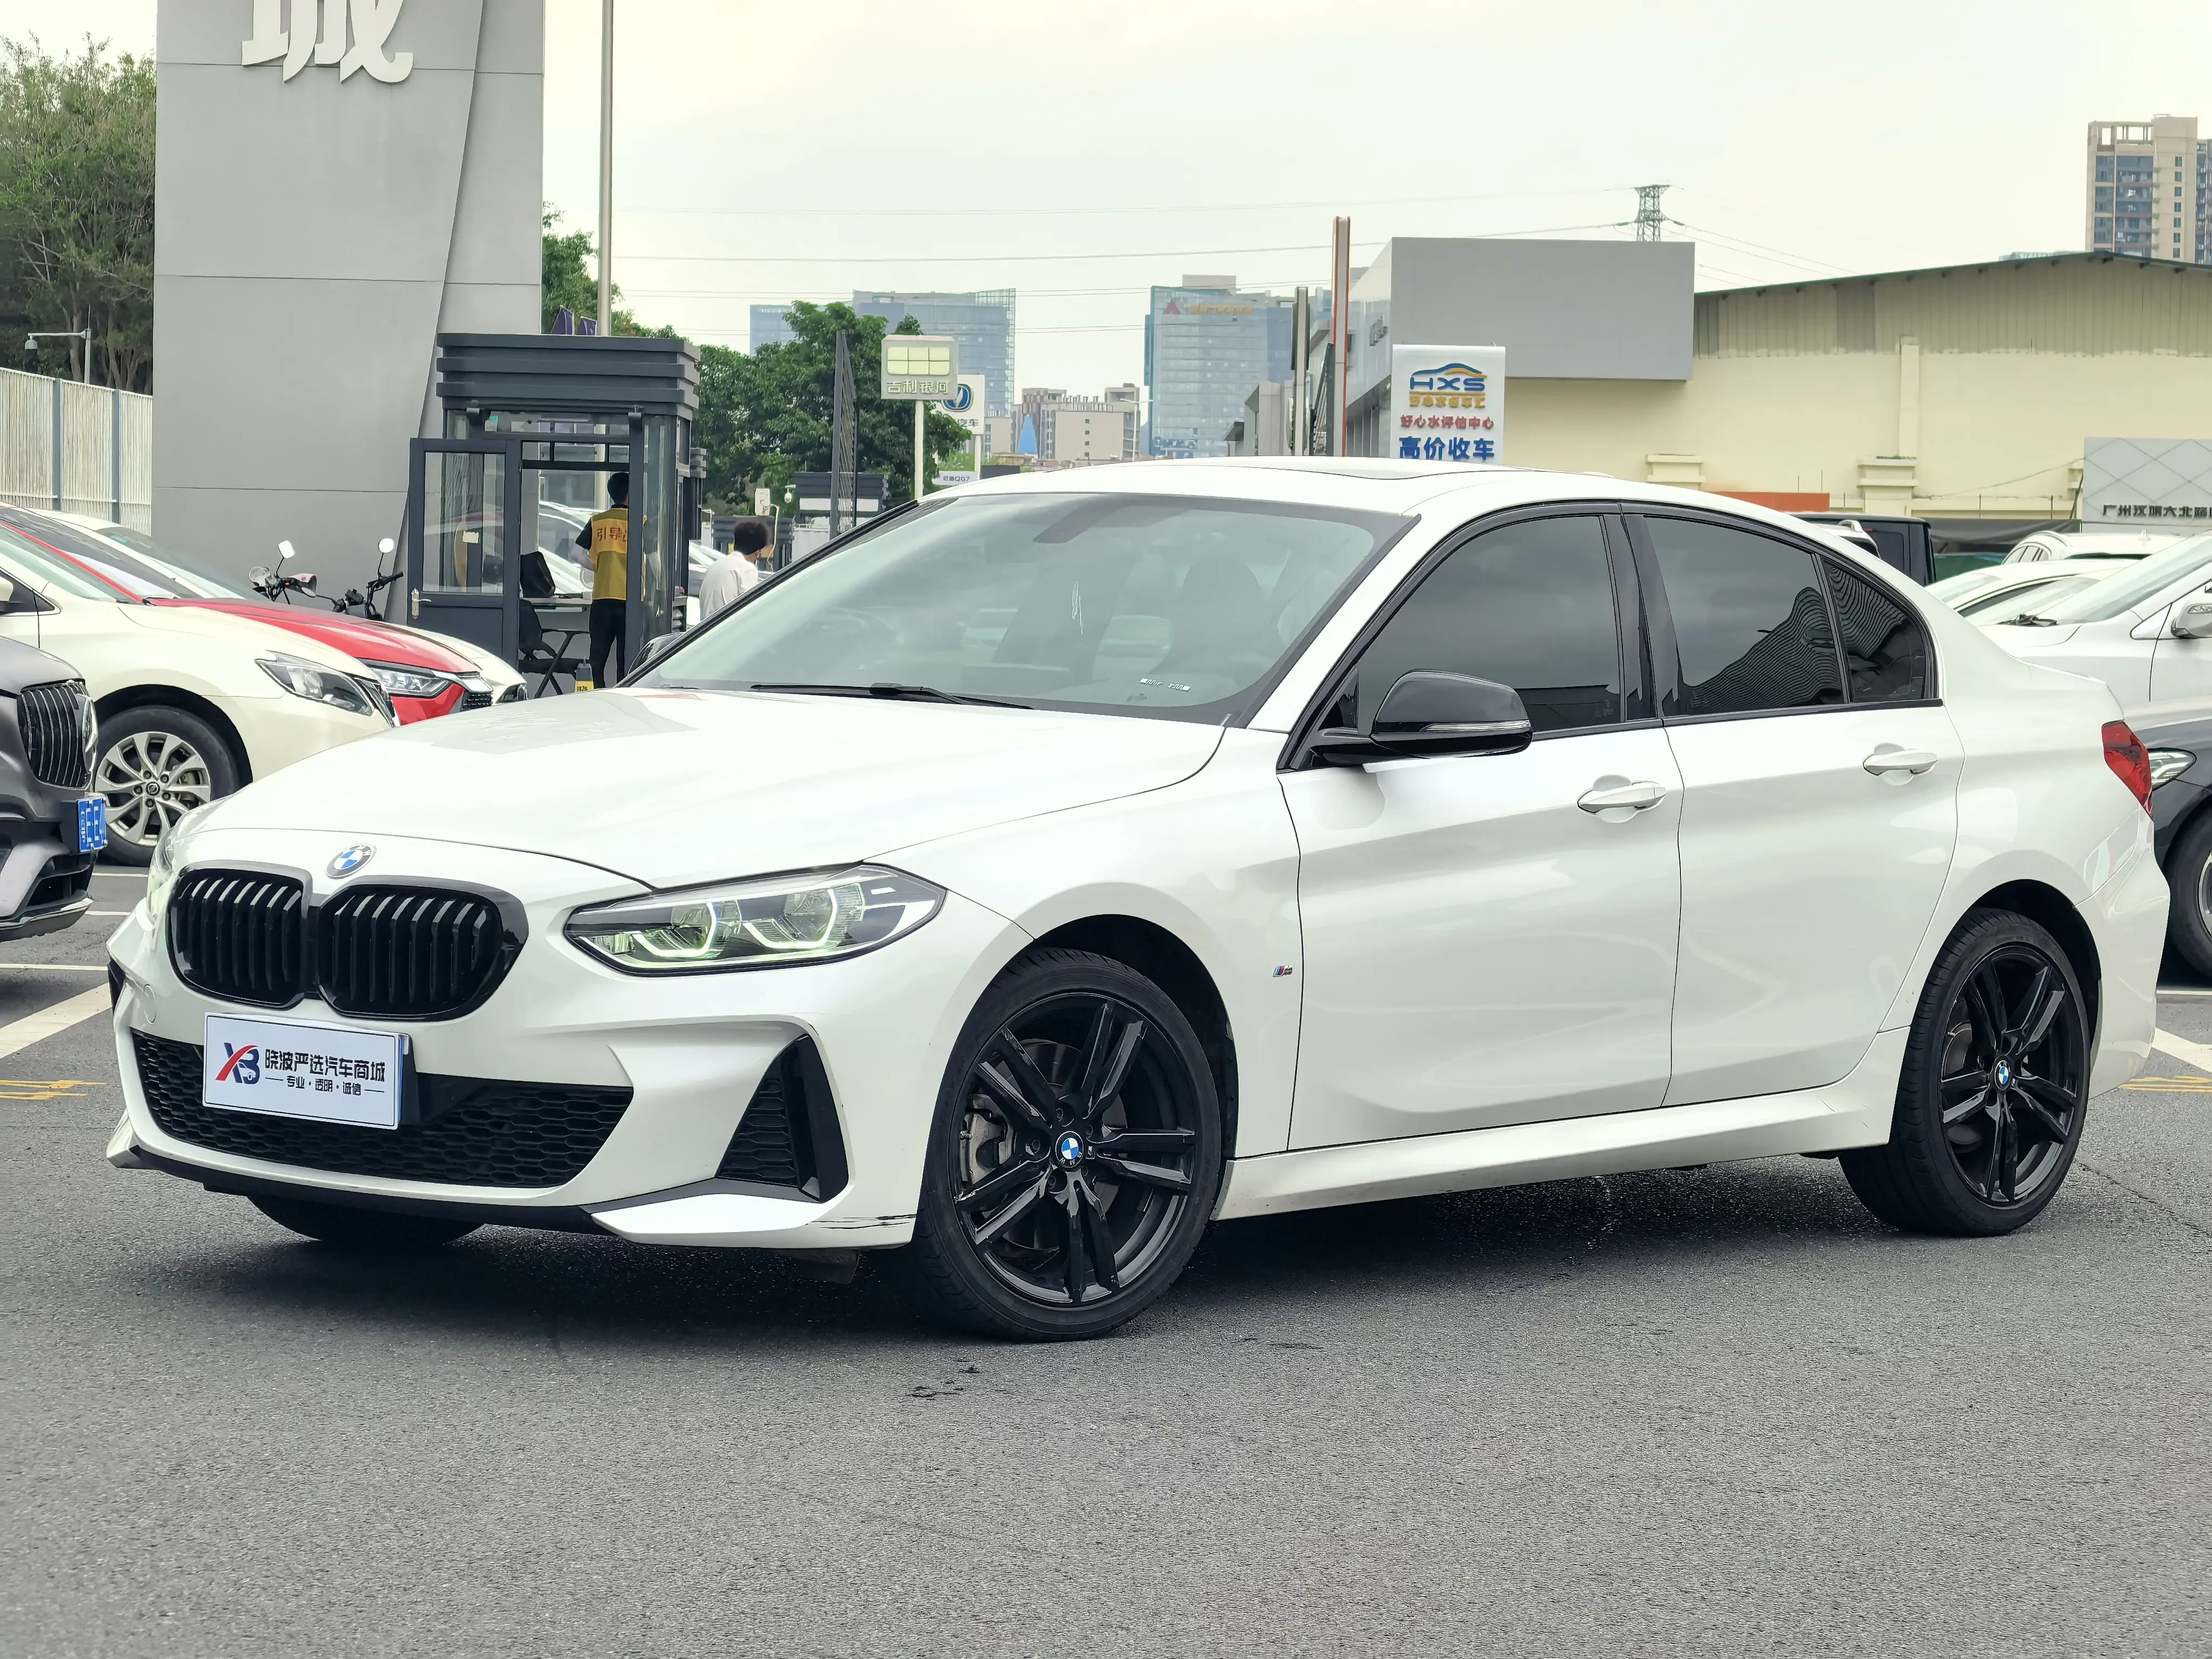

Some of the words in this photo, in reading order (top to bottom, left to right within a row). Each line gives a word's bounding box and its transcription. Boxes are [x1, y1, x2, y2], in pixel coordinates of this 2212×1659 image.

[887, 380, 949, 394] 吉利银河
[1410, 377, 1485, 391] HXS
[1399, 436, 1494, 460] 高价收车
[265, 1049, 386, 1082] 晓波严选汽车商城
